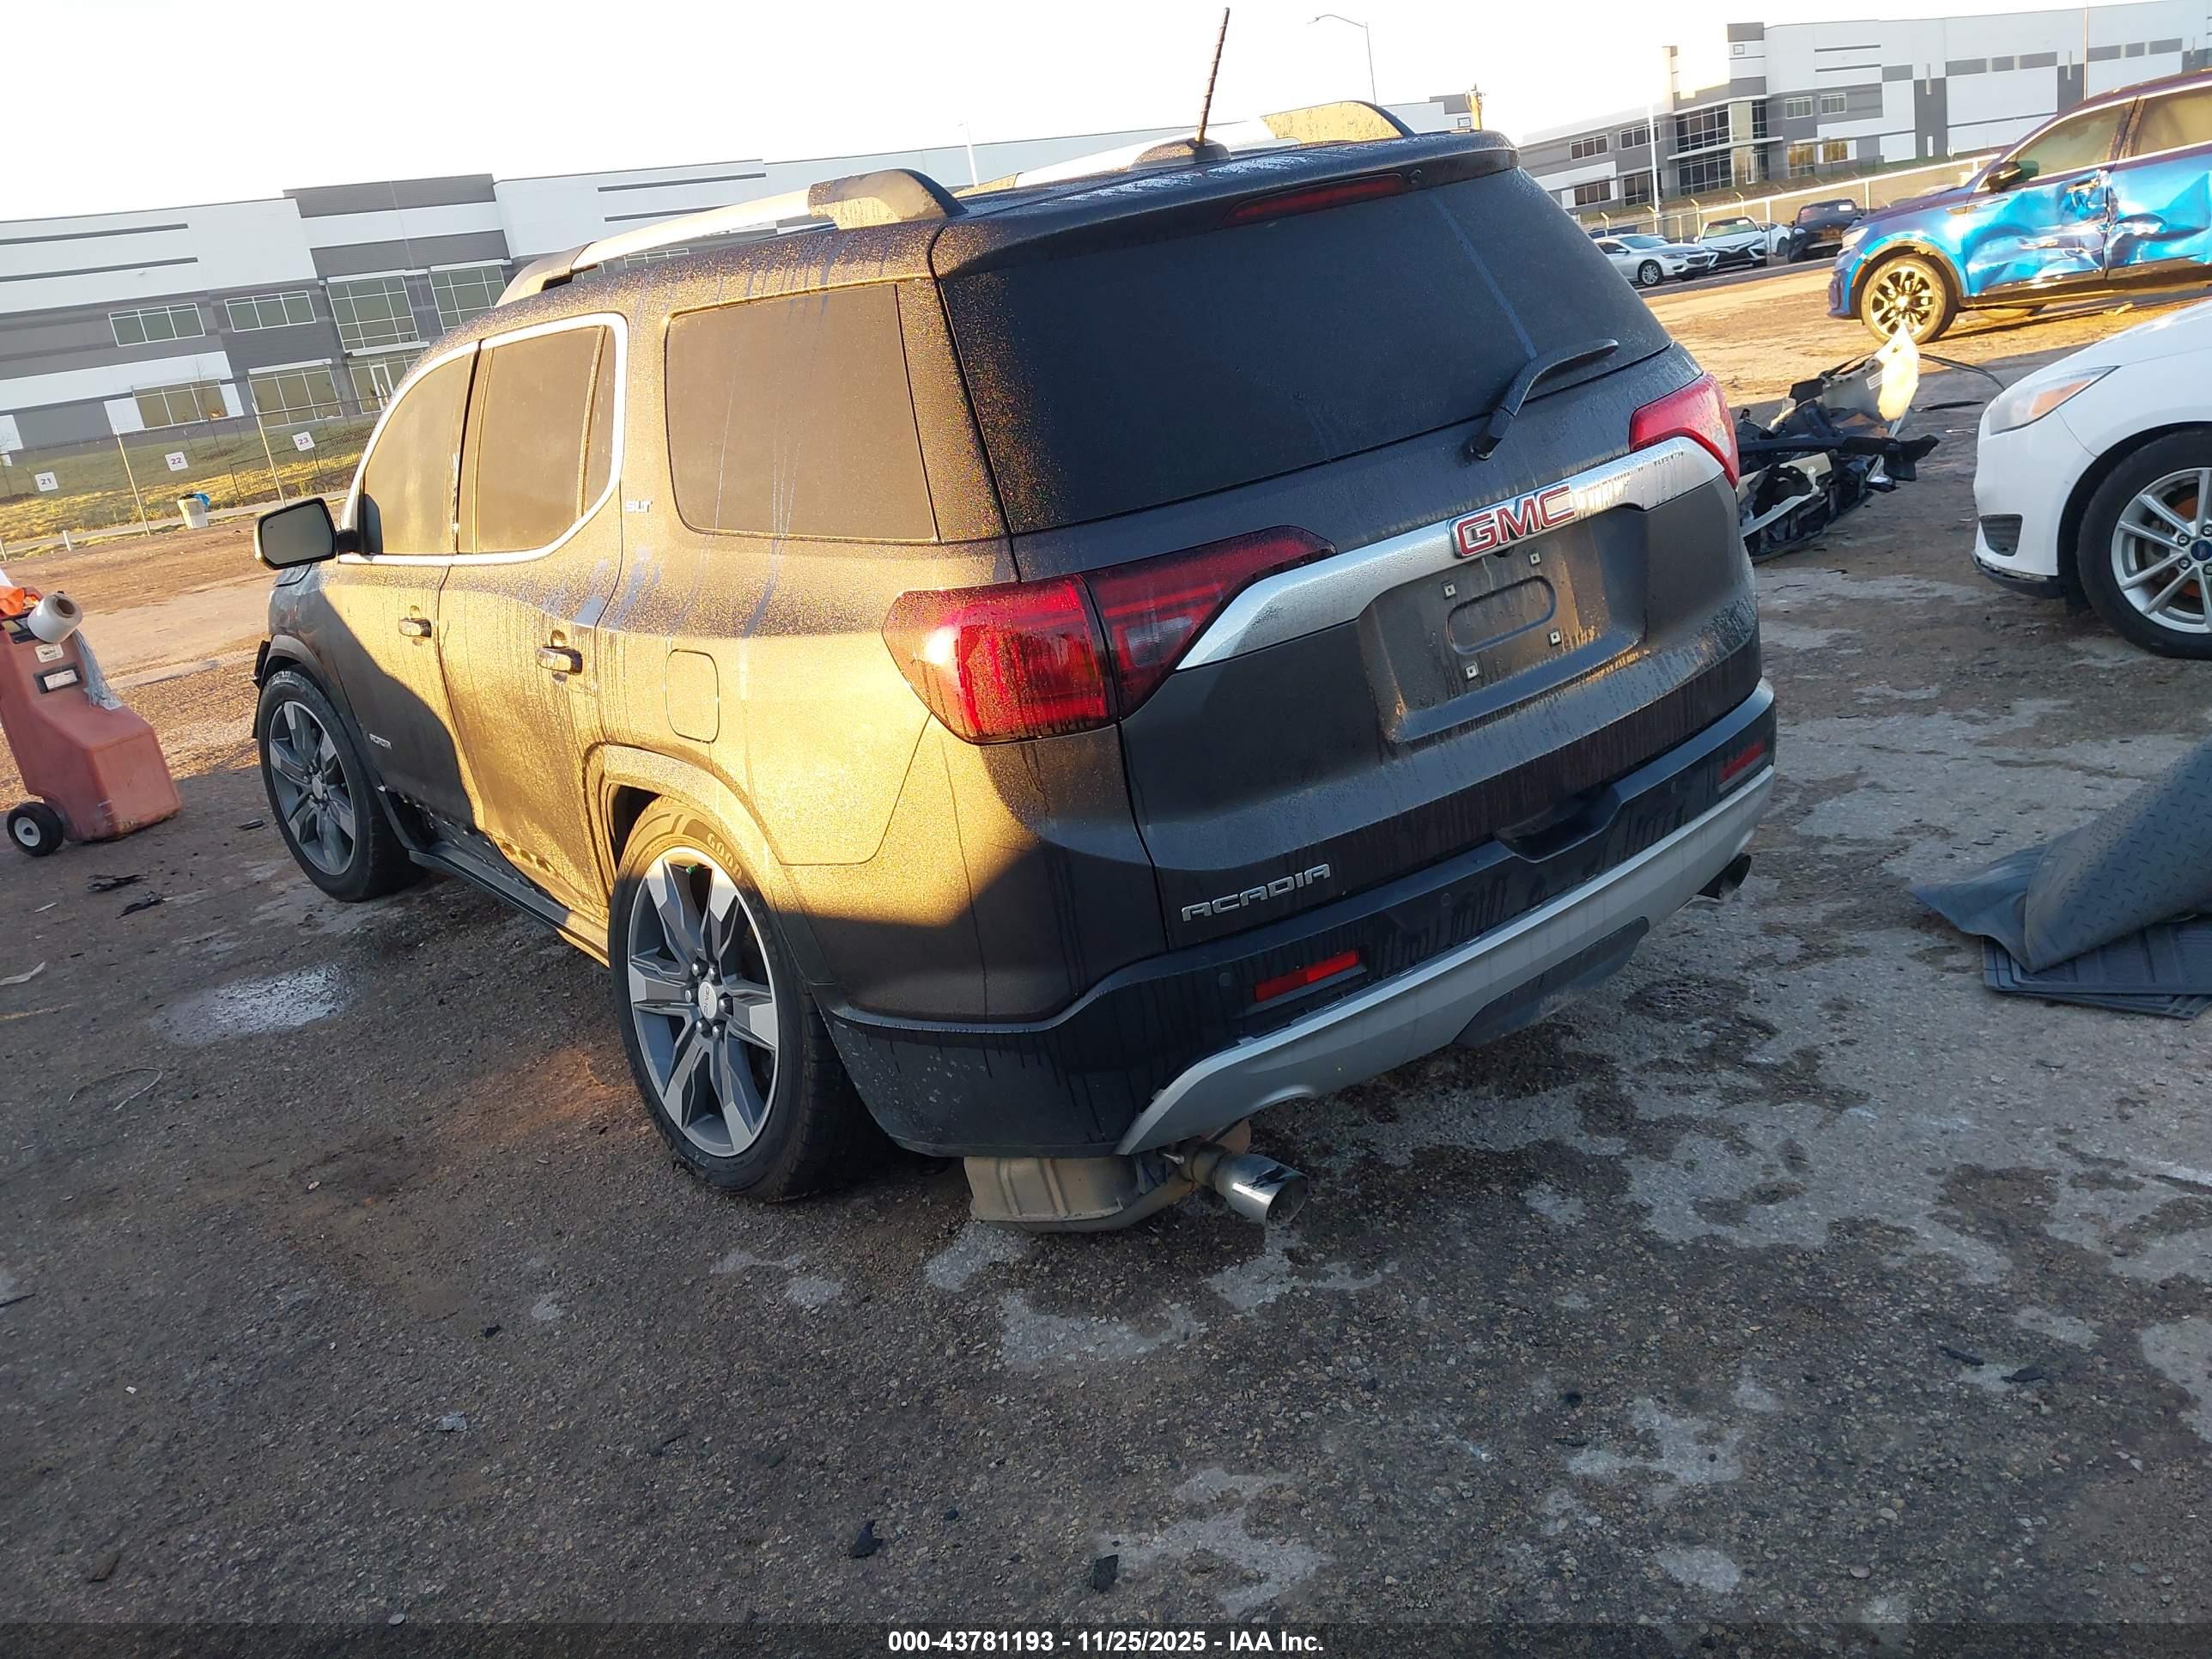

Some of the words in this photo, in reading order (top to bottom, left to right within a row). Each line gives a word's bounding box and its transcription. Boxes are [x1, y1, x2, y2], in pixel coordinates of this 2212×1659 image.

[297, 436, 310, 446] 23
[170, 456, 183, 465] 22
[40, 477, 53, 486] 21
[625, 499, 653, 514] SLT
[1455, 484, 1577, 556] GMC
[1181, 863, 1331, 922] ACADIA
